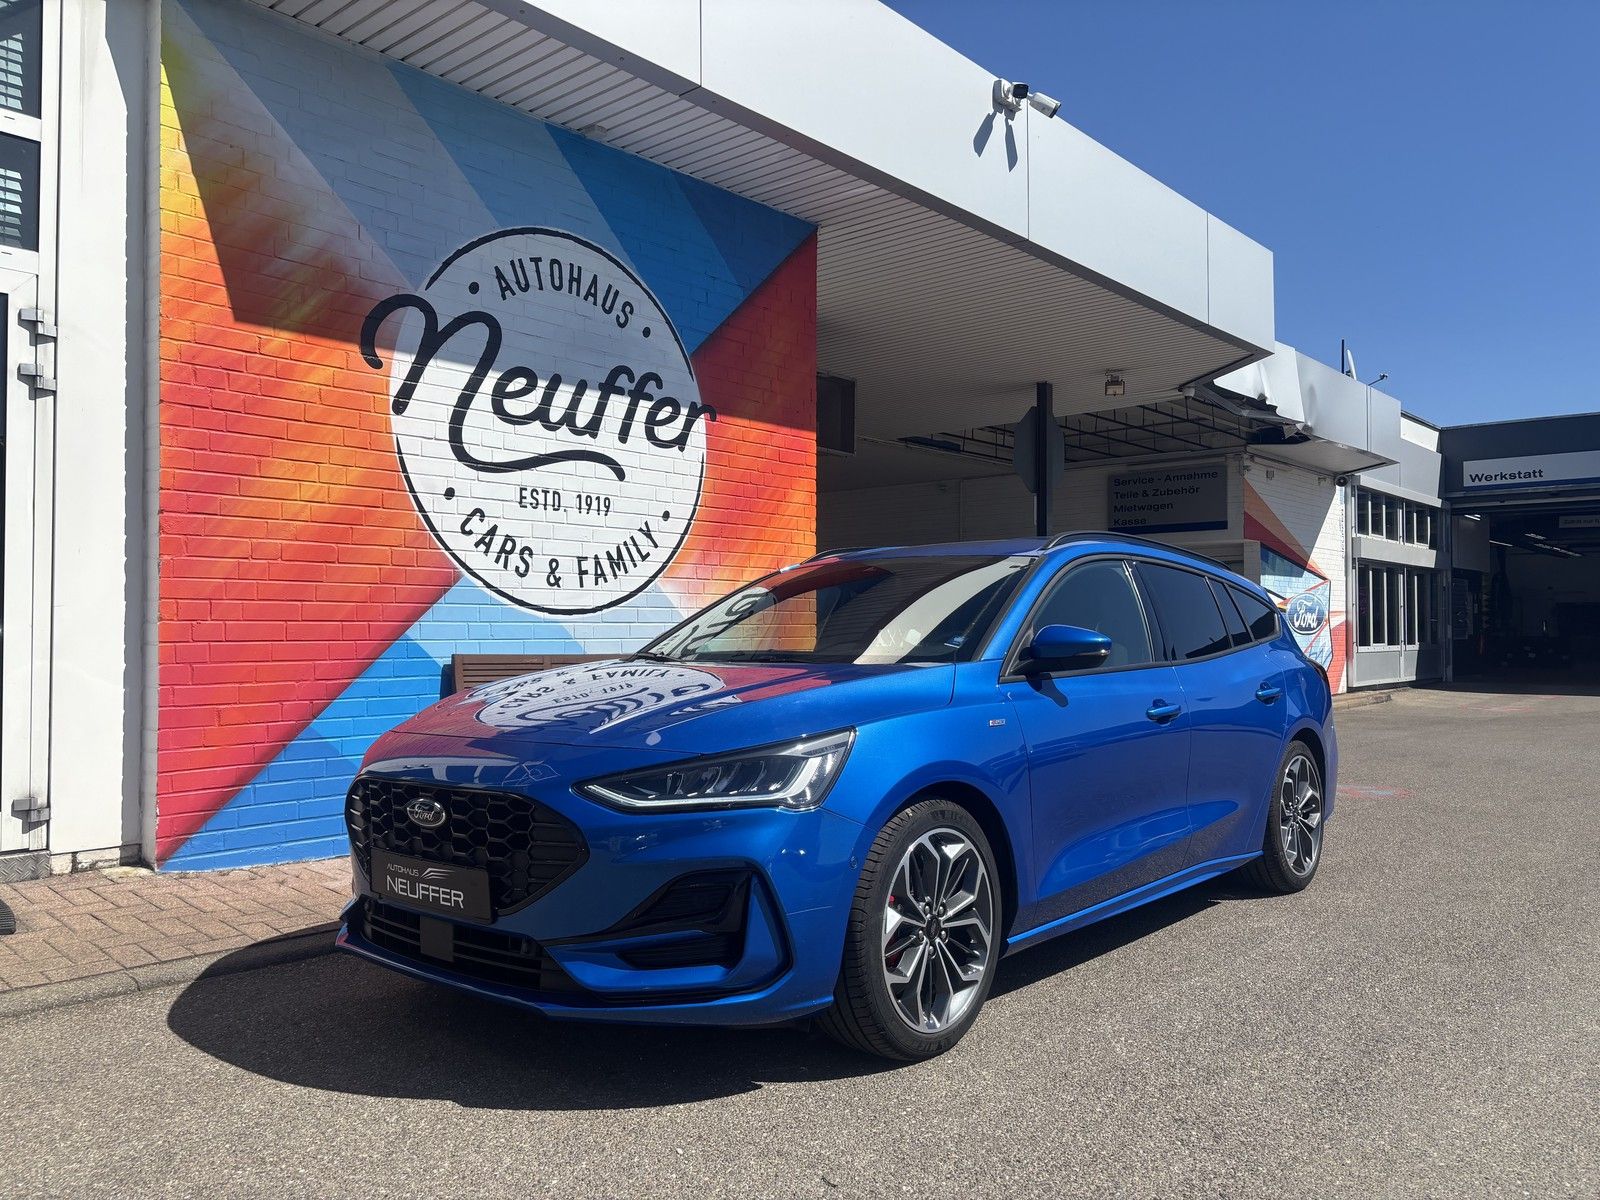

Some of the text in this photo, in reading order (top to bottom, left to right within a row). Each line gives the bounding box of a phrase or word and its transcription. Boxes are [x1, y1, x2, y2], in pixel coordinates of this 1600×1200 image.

[494, 256, 635, 329] AUTOHAUS
[360, 293, 717, 482] Neuffer
[1114, 475, 1154, 487] Service
[1164, 470, 1218, 483] Annahme
[1469, 469, 1544, 483] Werkstatt
[519, 487, 611, 517] ESTD. 1919
[1114, 486, 1200, 500] Teile & Zubehör
[1113, 502, 1173, 513] Mietwagen
[1113, 517, 1147, 526] Kasse
[460, 507, 660, 589] CARS & FAMILY
[1293, 600, 1319, 629] Ford
[413, 803, 435, 821] Ford
[387, 863, 419, 877] AUTOHAUS
[386, 875, 464, 909] NEUFFER
